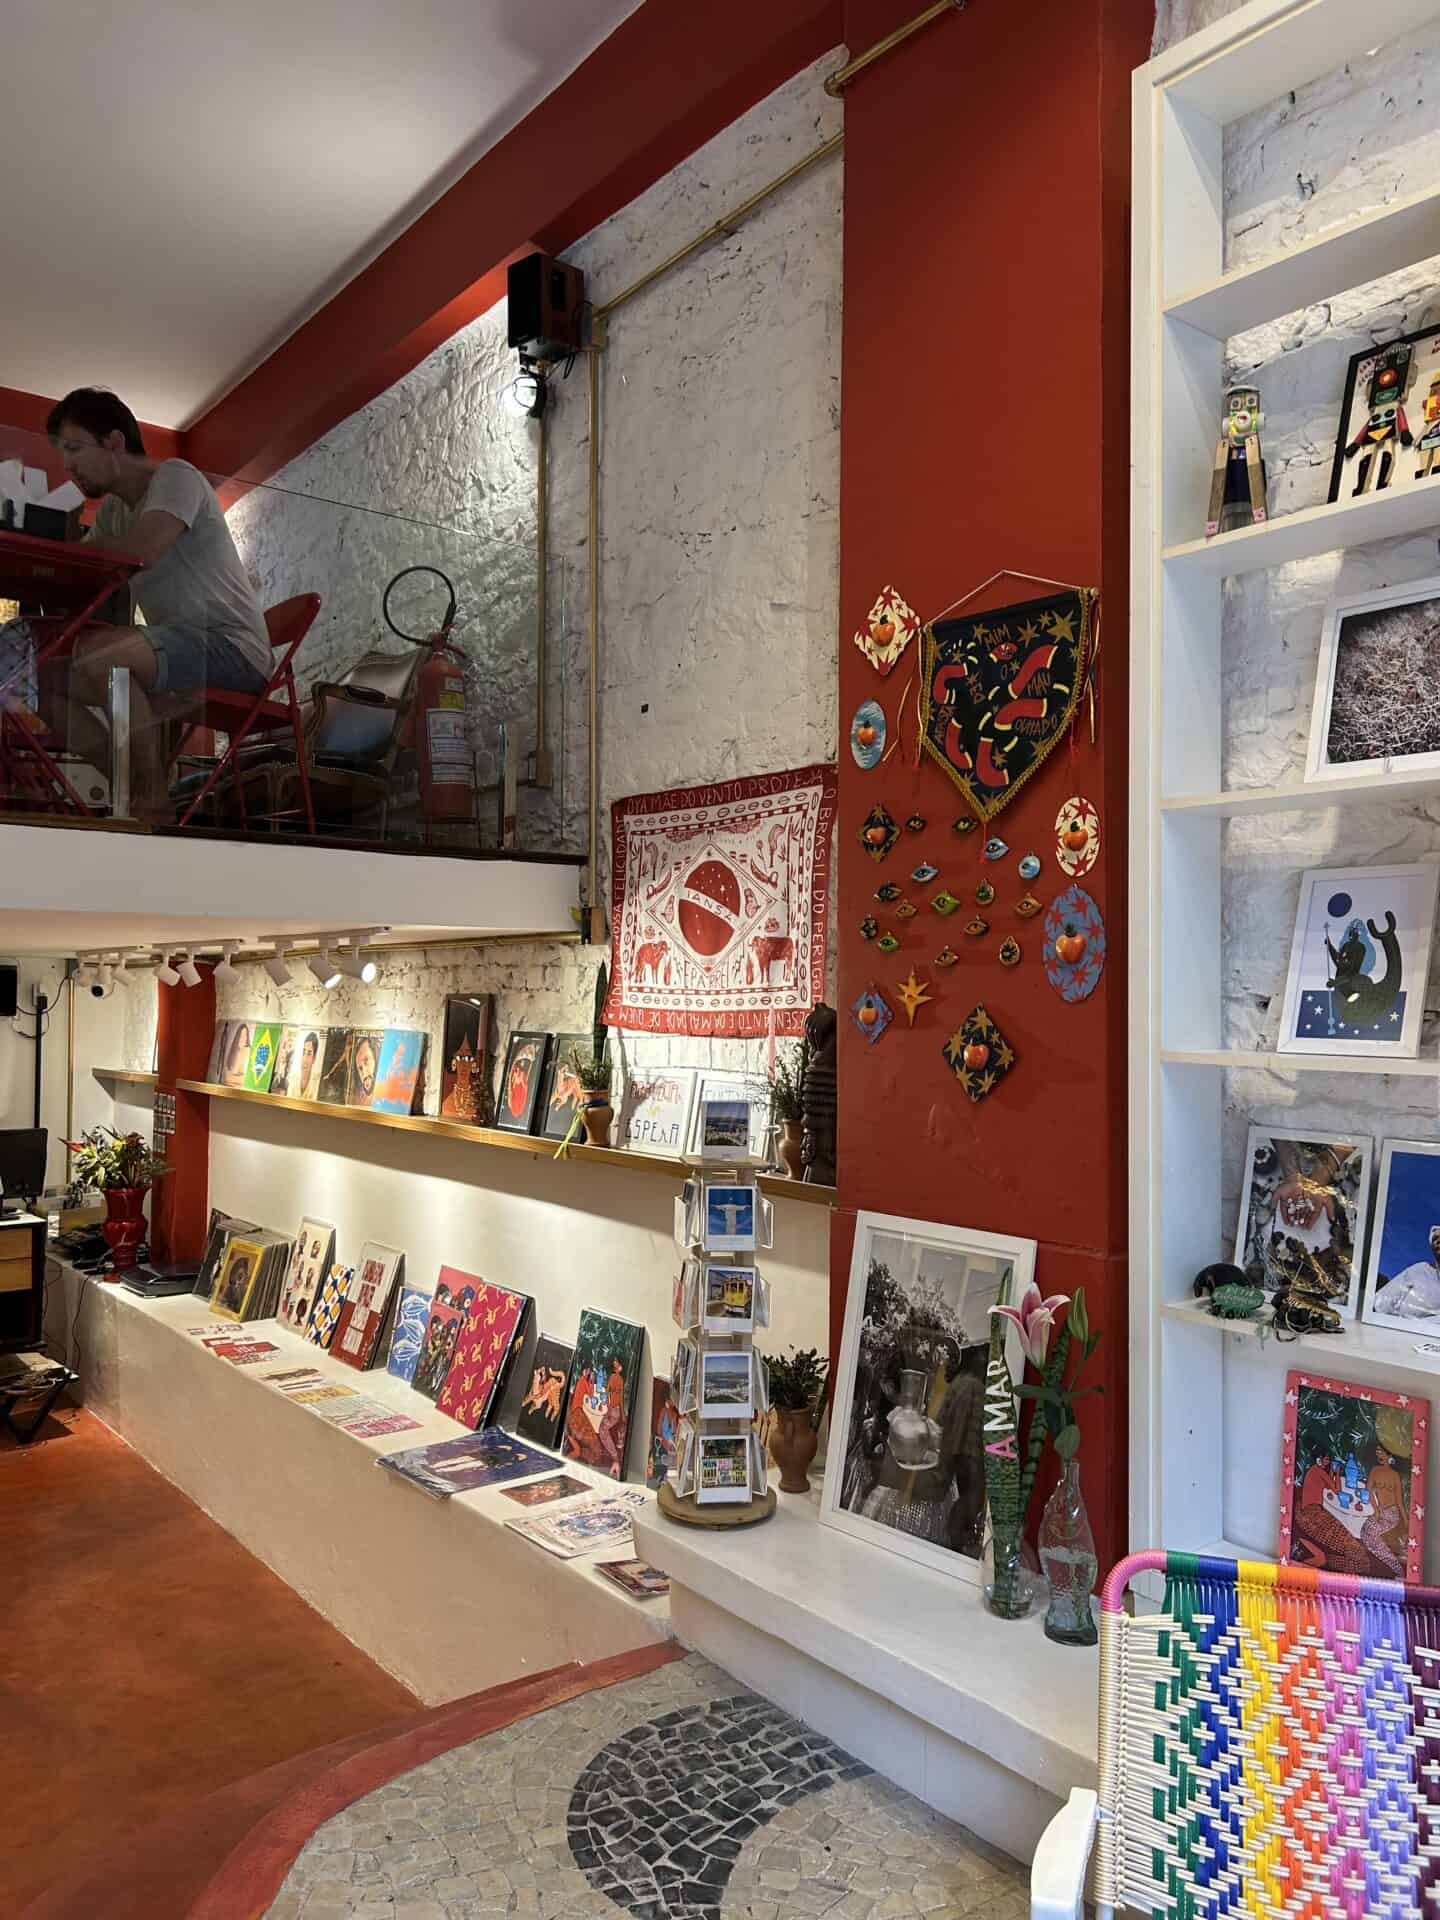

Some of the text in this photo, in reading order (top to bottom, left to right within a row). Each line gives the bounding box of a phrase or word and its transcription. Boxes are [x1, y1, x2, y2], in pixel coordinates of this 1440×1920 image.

[813, 807, 833, 882] BRASIL
[812, 889, 826, 914] DO
[811, 921, 825, 990] PERIGO
[619, 1006, 645, 1026] QUEM
[647, 1011, 661, 1027] DE
[729, 1013, 735, 1029] E
[983, 1355, 1018, 1459] AMAR
